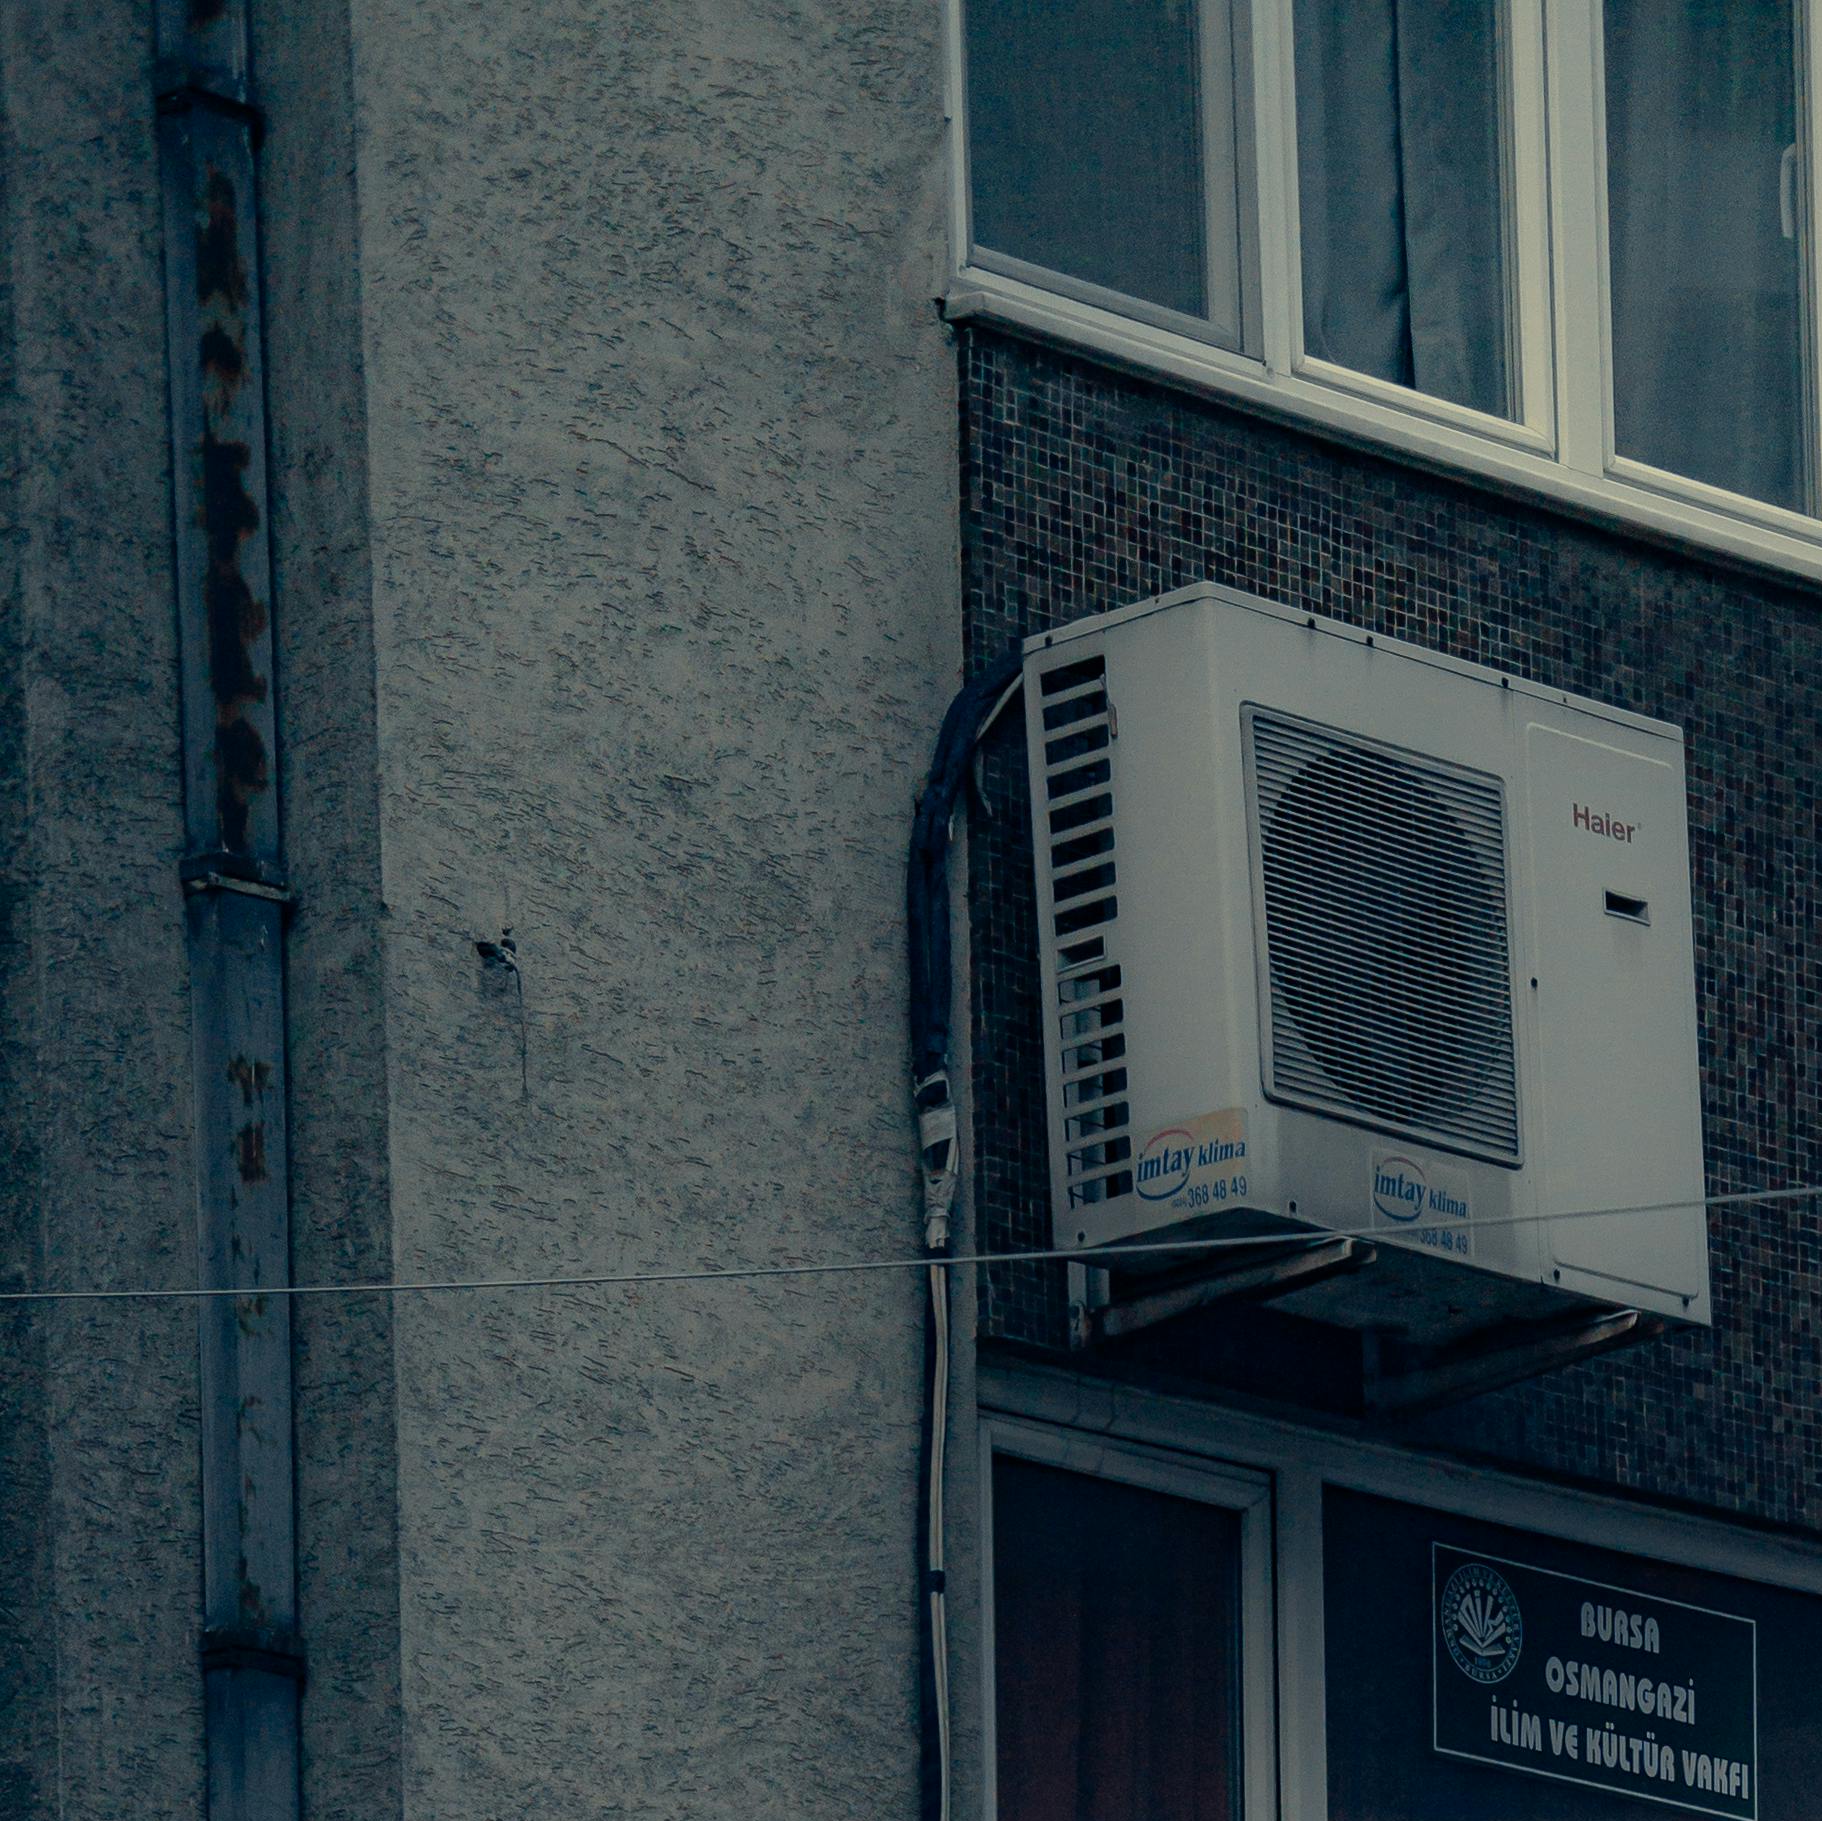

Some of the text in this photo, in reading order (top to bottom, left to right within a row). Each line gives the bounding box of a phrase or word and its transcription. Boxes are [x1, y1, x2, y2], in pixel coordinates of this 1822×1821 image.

[1573, 803, 1635, 843] Haier
[1136, 1138, 1246, 1184] imtay klima
[1187, 1183, 1210, 1209] 368
[1212, 1178, 1227, 1200] 48
[1231, 1175, 1247, 1197] 49
[1374, 1165, 1467, 1219] imtay klima
[1580, 1601, 1661, 1655] BURSA
[1545, 1656, 1696, 1726] OSMANGAZİ
[1490, 1694, 1749, 1800] İLİM VE KÜLTÜR VAKFI
